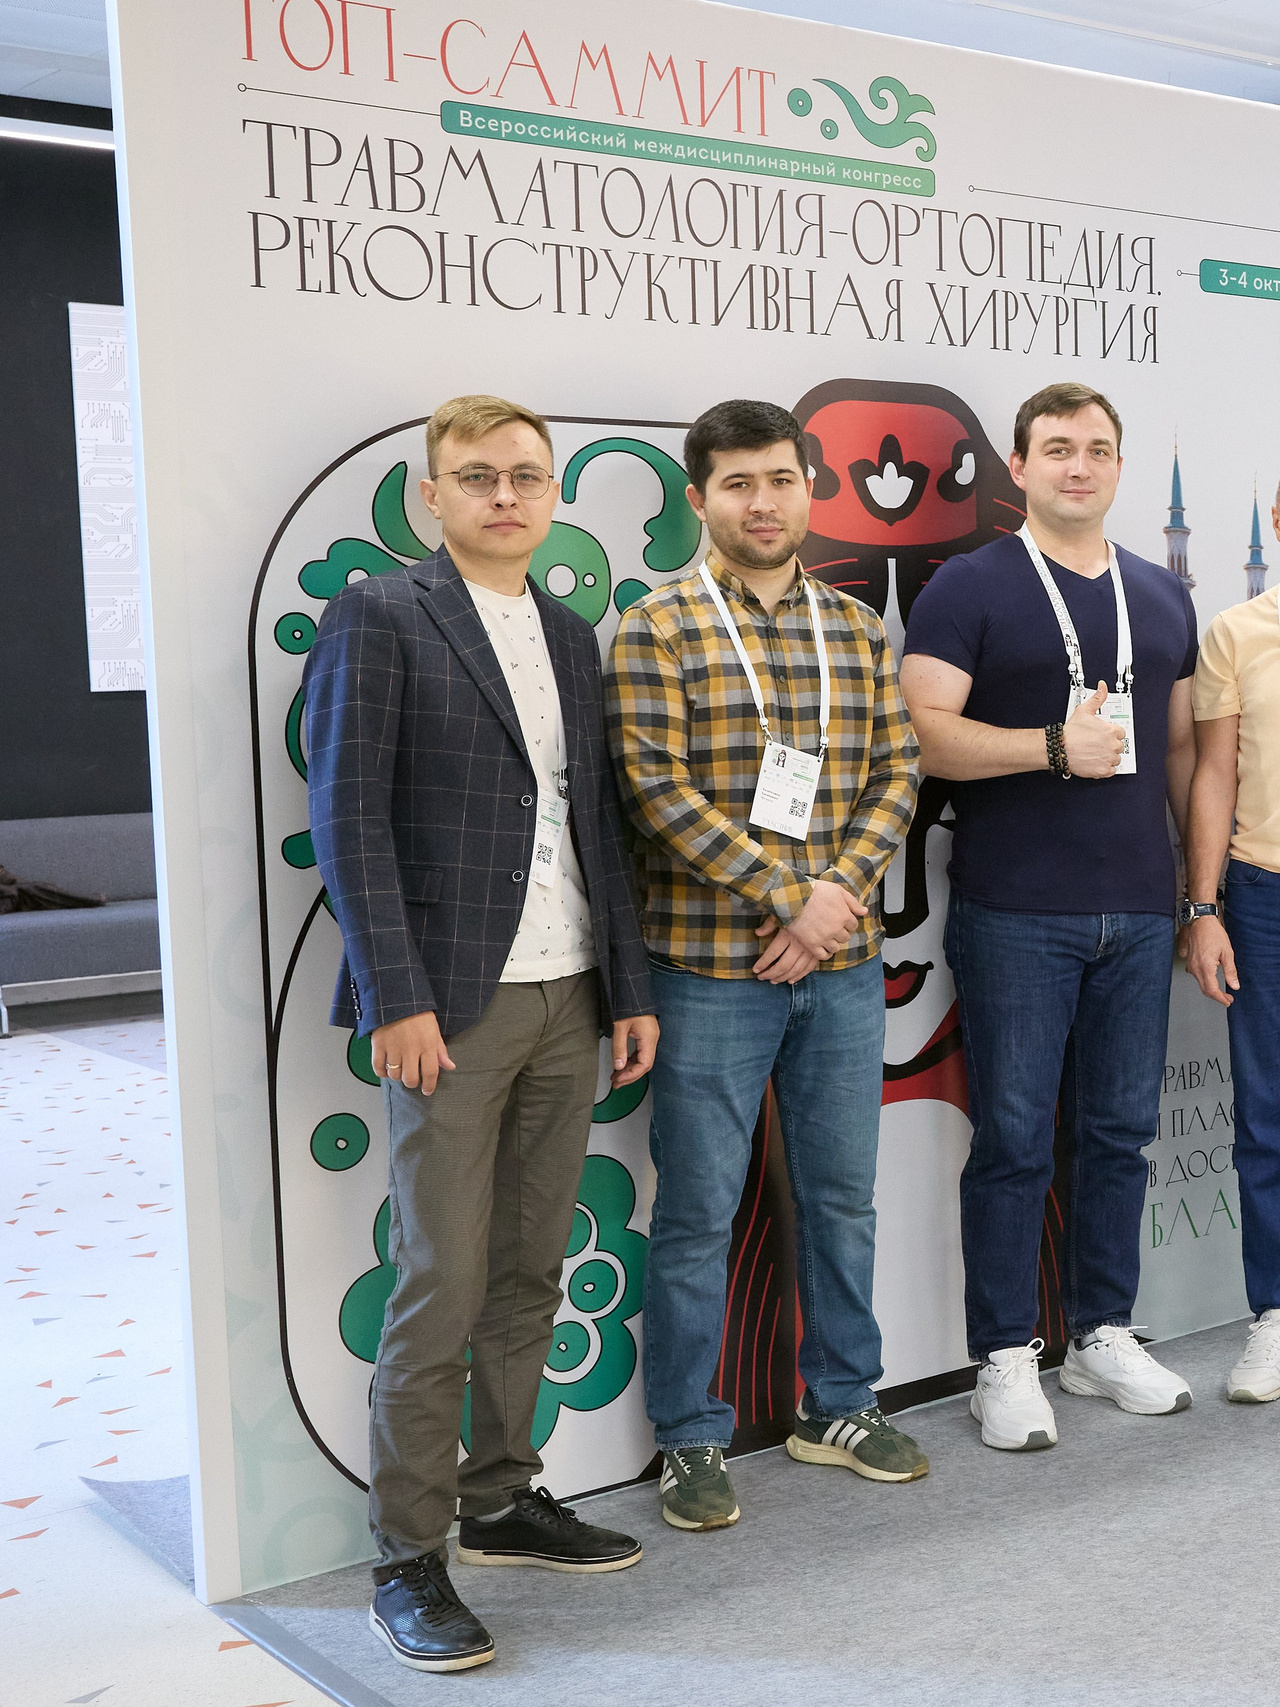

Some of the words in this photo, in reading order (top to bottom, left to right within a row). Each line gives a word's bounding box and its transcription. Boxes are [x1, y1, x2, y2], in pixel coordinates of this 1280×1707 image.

[240, 0, 777, 137] ТОП-САММИТ
[459, 110, 627, 150] Всероссийский
[633, 138, 837, 178] междисциплинарный
[842, 163, 923, 190] конгресс
[247, 211, 906, 344] РЕКОНСТРУКТИВНАЯ
[926, 282, 1160, 365] ХИРУРГИЯ
[1219, 268, 1248, 289] 3-4
[1149, 1160, 1157, 1188] В
